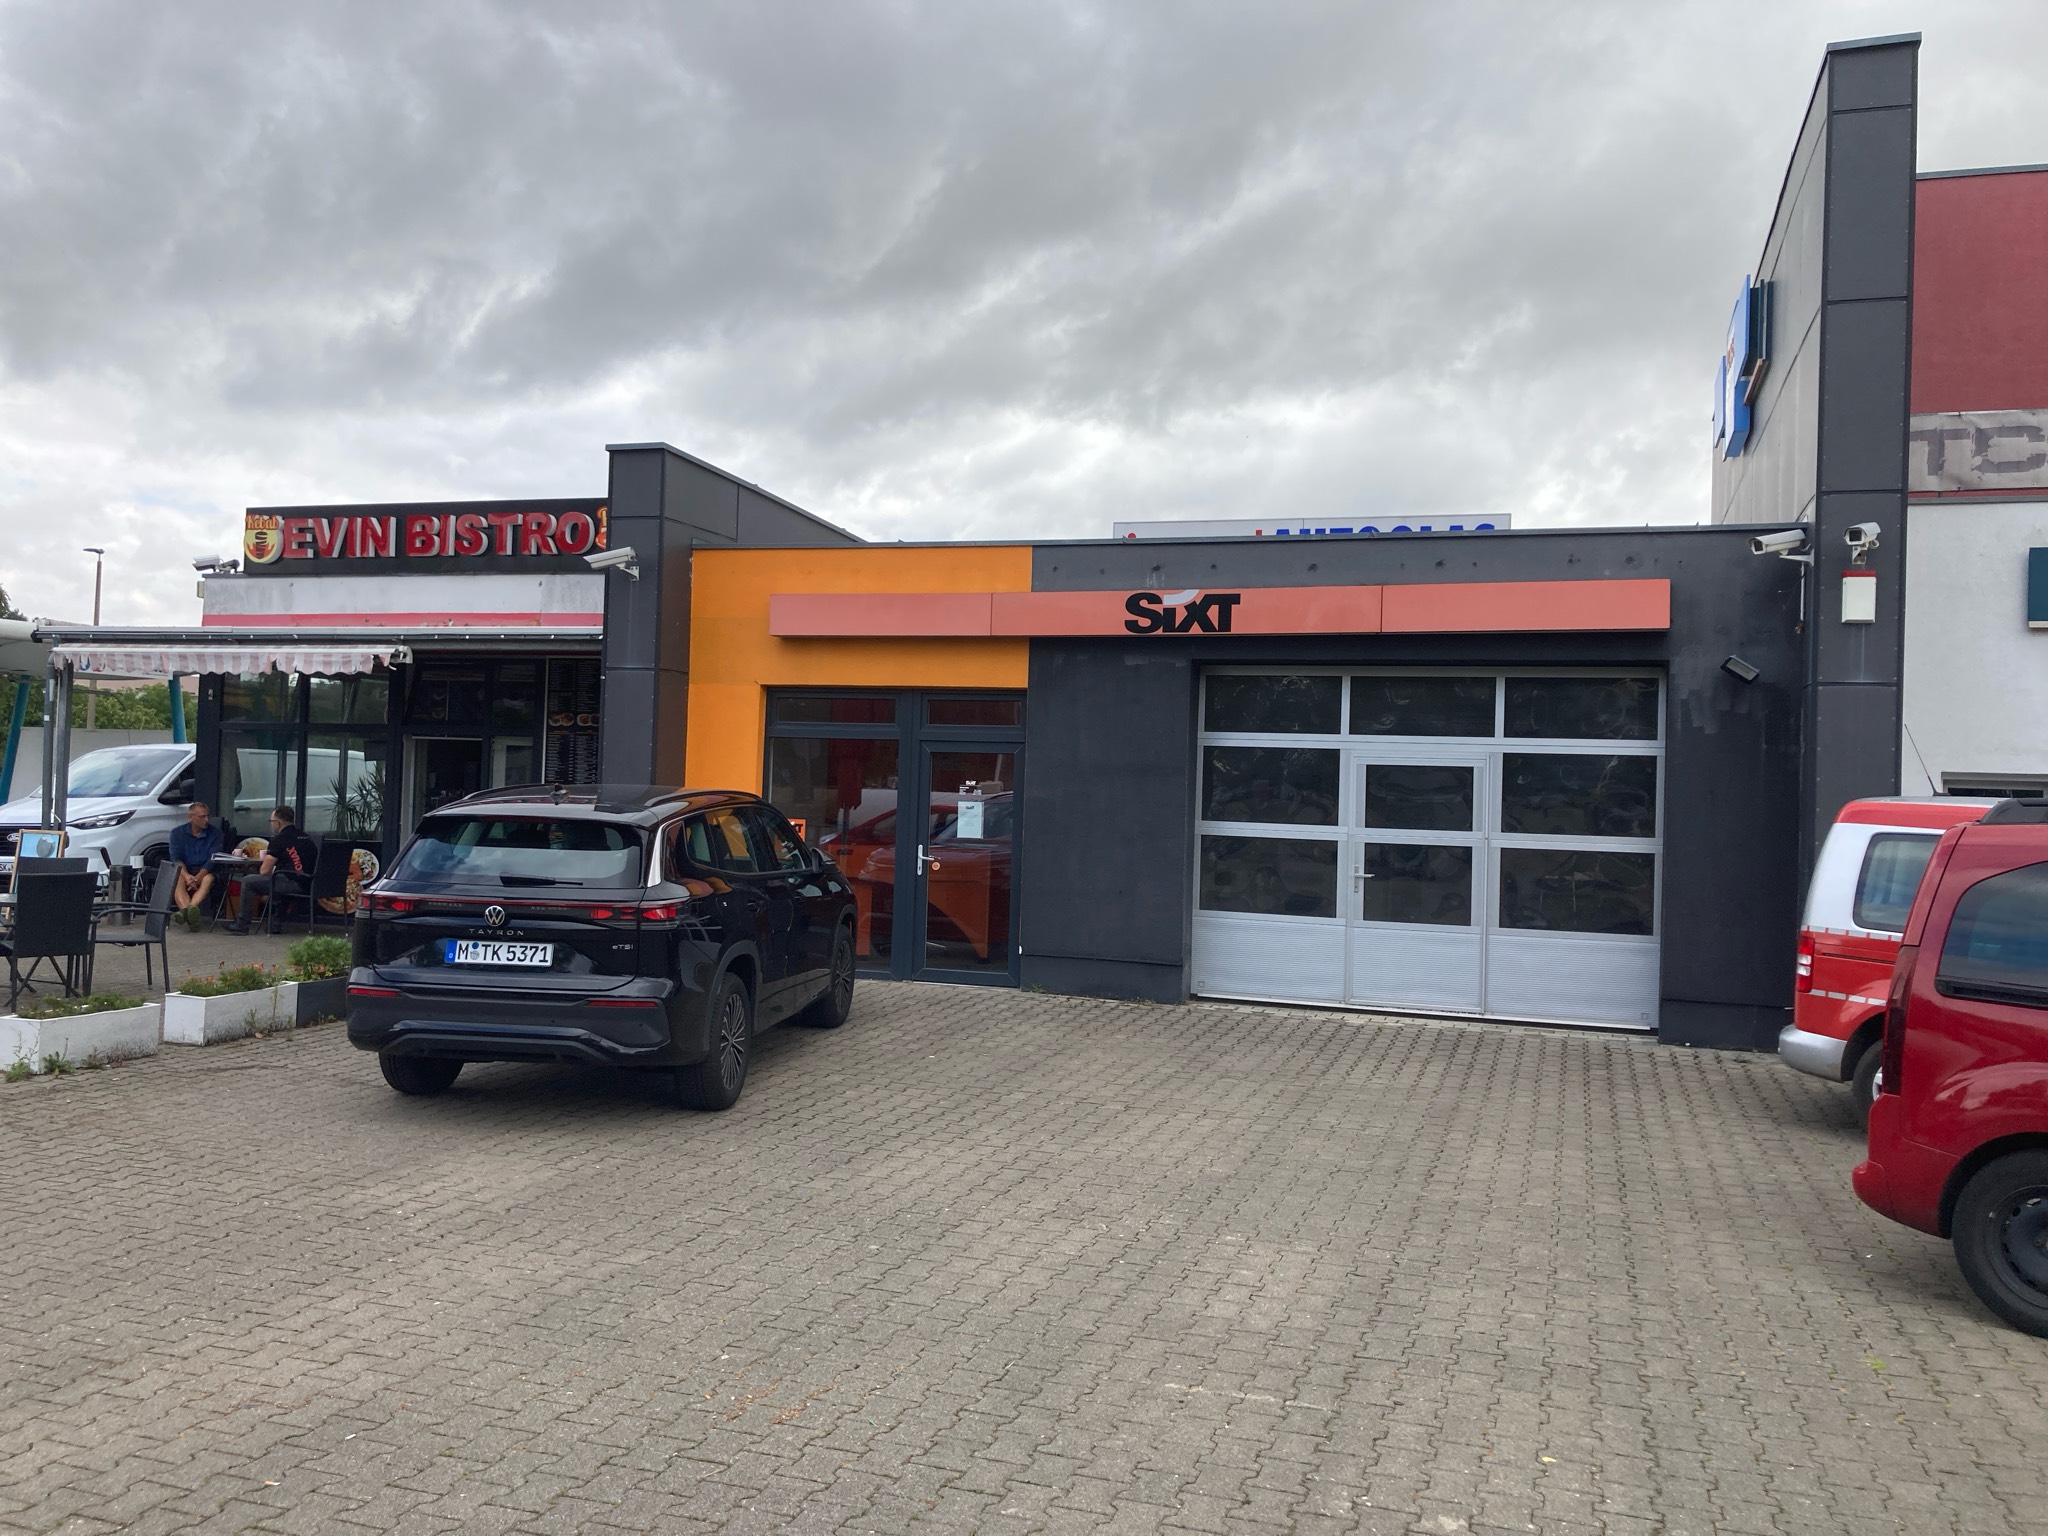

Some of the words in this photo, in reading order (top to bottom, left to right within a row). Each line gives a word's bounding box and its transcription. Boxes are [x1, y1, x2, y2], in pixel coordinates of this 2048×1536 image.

[245, 514, 279, 530] Kebab
[283, 515, 397, 559] EVIN
[405, 511, 595, 557] BISTRO
[469, 928, 524, 936] TAYRON
[457, 943, 469, 960] M
[481, 943, 503, 962] TK
[506, 944, 549, 963] 5371
